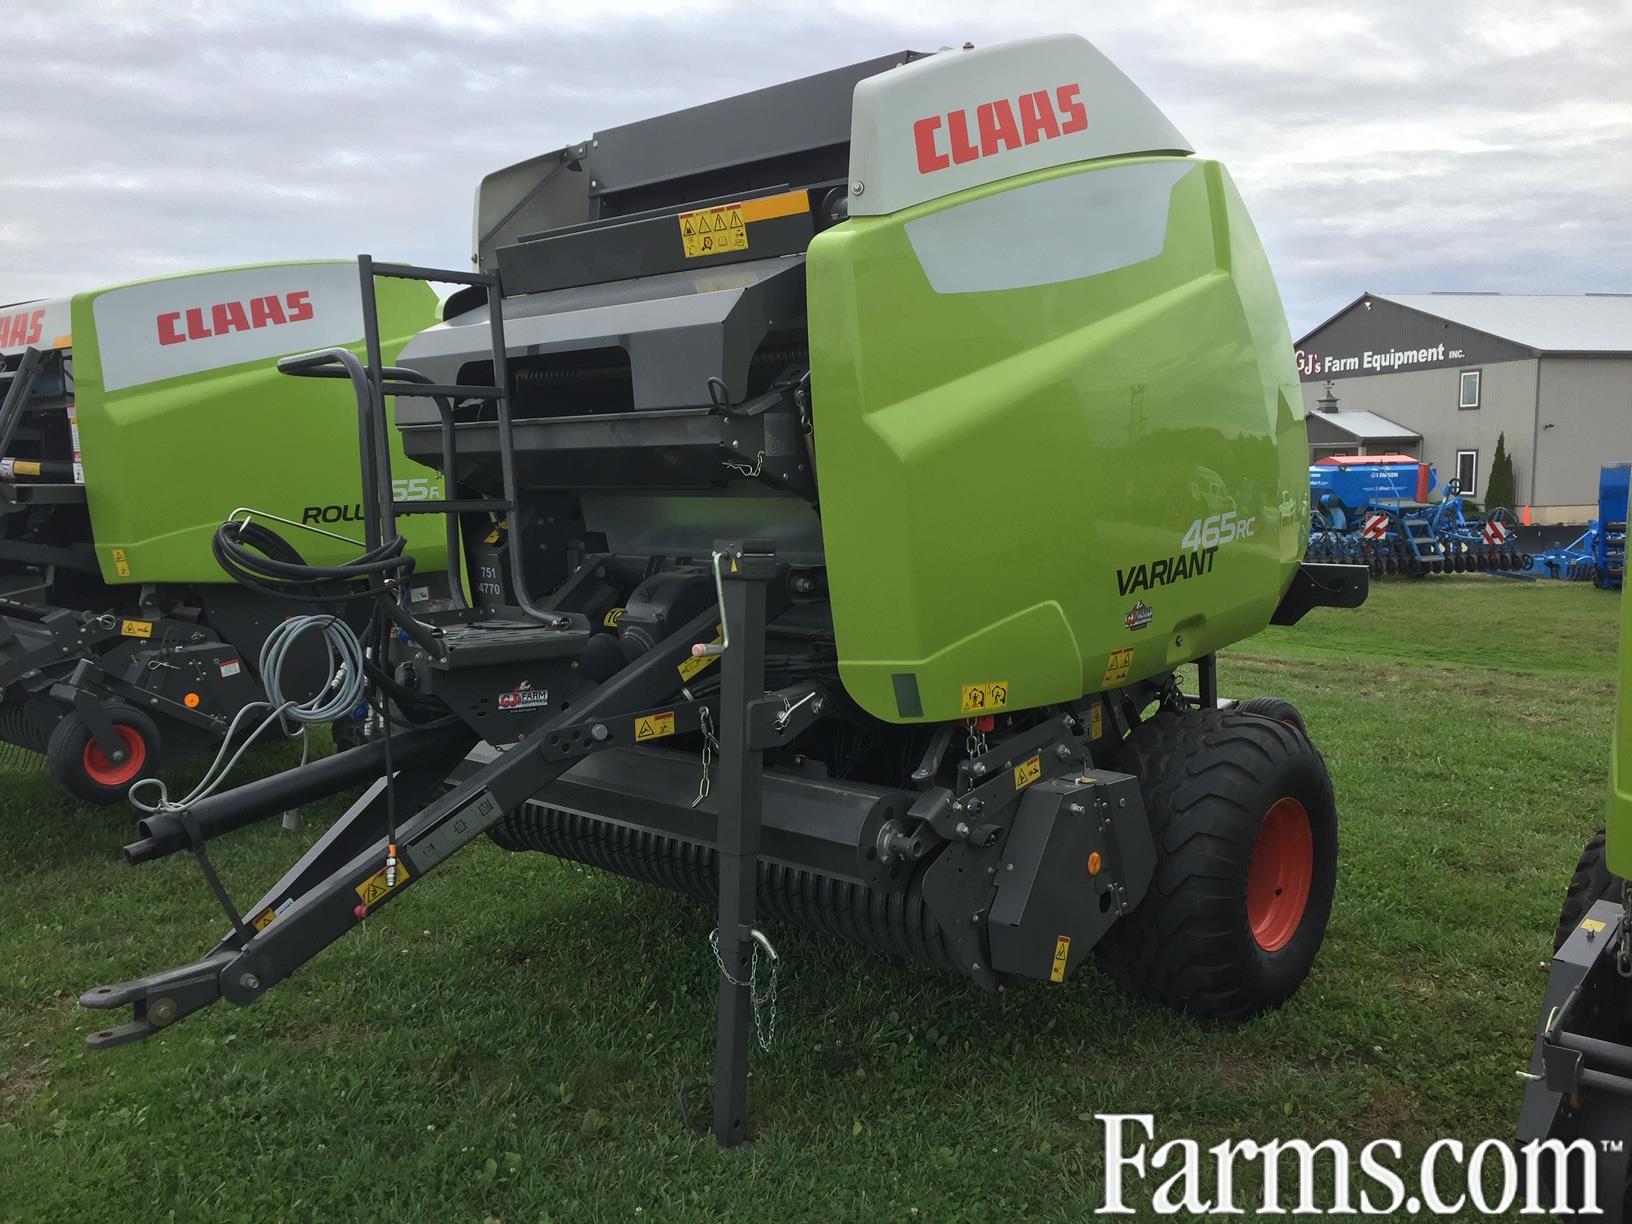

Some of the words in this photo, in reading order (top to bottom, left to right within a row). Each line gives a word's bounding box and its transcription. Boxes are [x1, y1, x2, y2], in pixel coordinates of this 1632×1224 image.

[914, 83, 1088, 174] CLAAS
[0, 309, 46, 348] AAS
[156, 290, 314, 346] CLAAS
[1325, 356, 1359, 373] Farm
[1364, 343, 1445, 371] Equipment
[478, 582, 501, 595] 4770
[480, 566, 496, 579] 751
[1116, 546, 1218, 597] VARIANT
